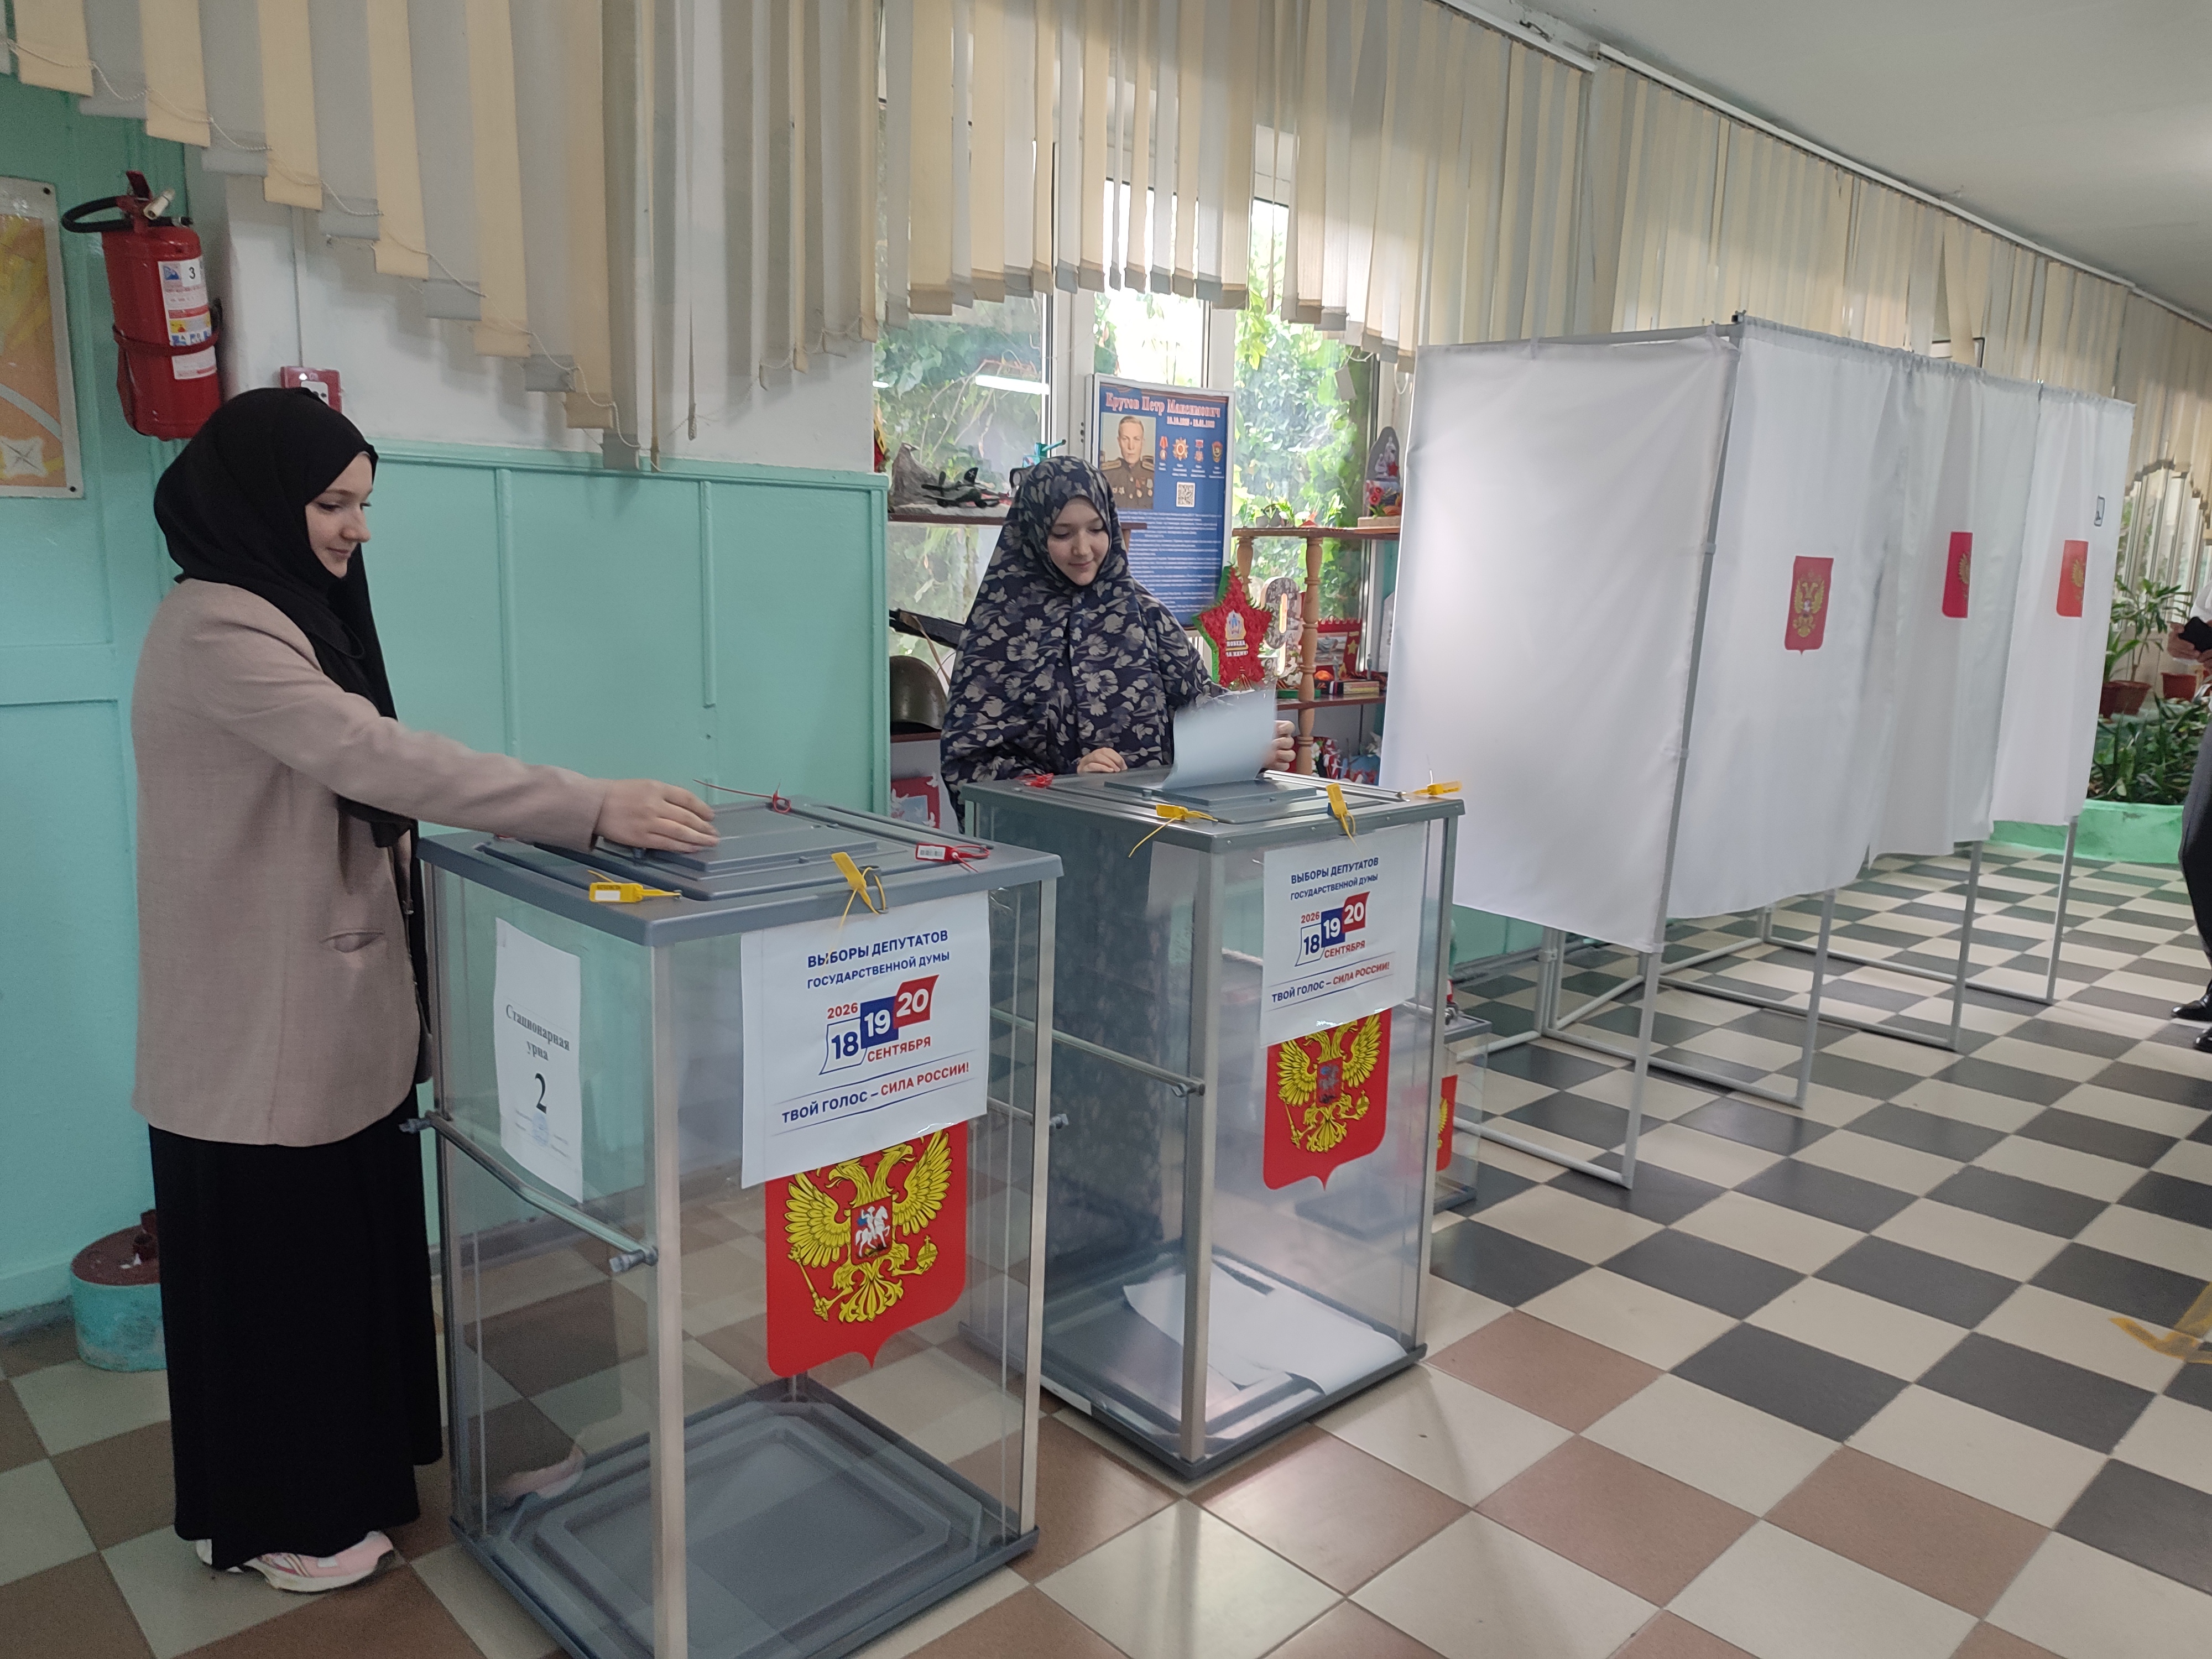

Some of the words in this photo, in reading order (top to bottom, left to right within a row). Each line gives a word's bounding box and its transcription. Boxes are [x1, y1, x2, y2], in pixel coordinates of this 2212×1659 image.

[189, 267, 196, 279] 3
[1291, 868, 1329, 884] ВЫБОРЫ
[1331, 857, 1379, 876] ДЕПУТАТОВ
[1291, 877, 1358, 900] ГОСУДАРСТВЕННОЙ
[1359, 874, 1378, 885] ДУМЫ
[1301, 912, 1319, 924] 2026
[1344, 902, 1364, 924] 20
[1323, 917, 1340, 939] 19
[807, 945, 869, 968] ВЫБОРЫ
[872, 930, 948, 957] ДЕПУТАТОВ
[1303, 935, 1319, 956] 18
[1324, 941, 1365, 958] СЕНТЯБРЯ
[807, 956, 916, 989] ГОСУДАРСТВЕННОЙ
[918, 951, 950, 972] ДУМЫ
[1272, 987, 1295, 1002] ТВОЙ
[1297, 980, 1324, 996] ГОЛОС
[1333, 972, 1354, 985] СИЛА
[1355, 962, 1390, 979] РОССИИ!
[827, 1003, 858, 1020] 2026
[896, 989, 929, 1018] 20
[505, 1004, 570, 1051] Стационарная
[864, 1010, 891, 1037] 19
[526, 1041, 549, 1061] урна
[831, 1032, 859, 1060] 18
[867, 1037, 931, 1062] СЕНТЯБРЯ
[534, 1073, 547, 1114] 2
[782, 1100, 819, 1123] ТВОЙ
[822, 1091, 868, 1113] ГОЛОС
[881, 1076, 915, 1096] СИЛА
[917, 1062, 969, 1086] РОССИИ!
